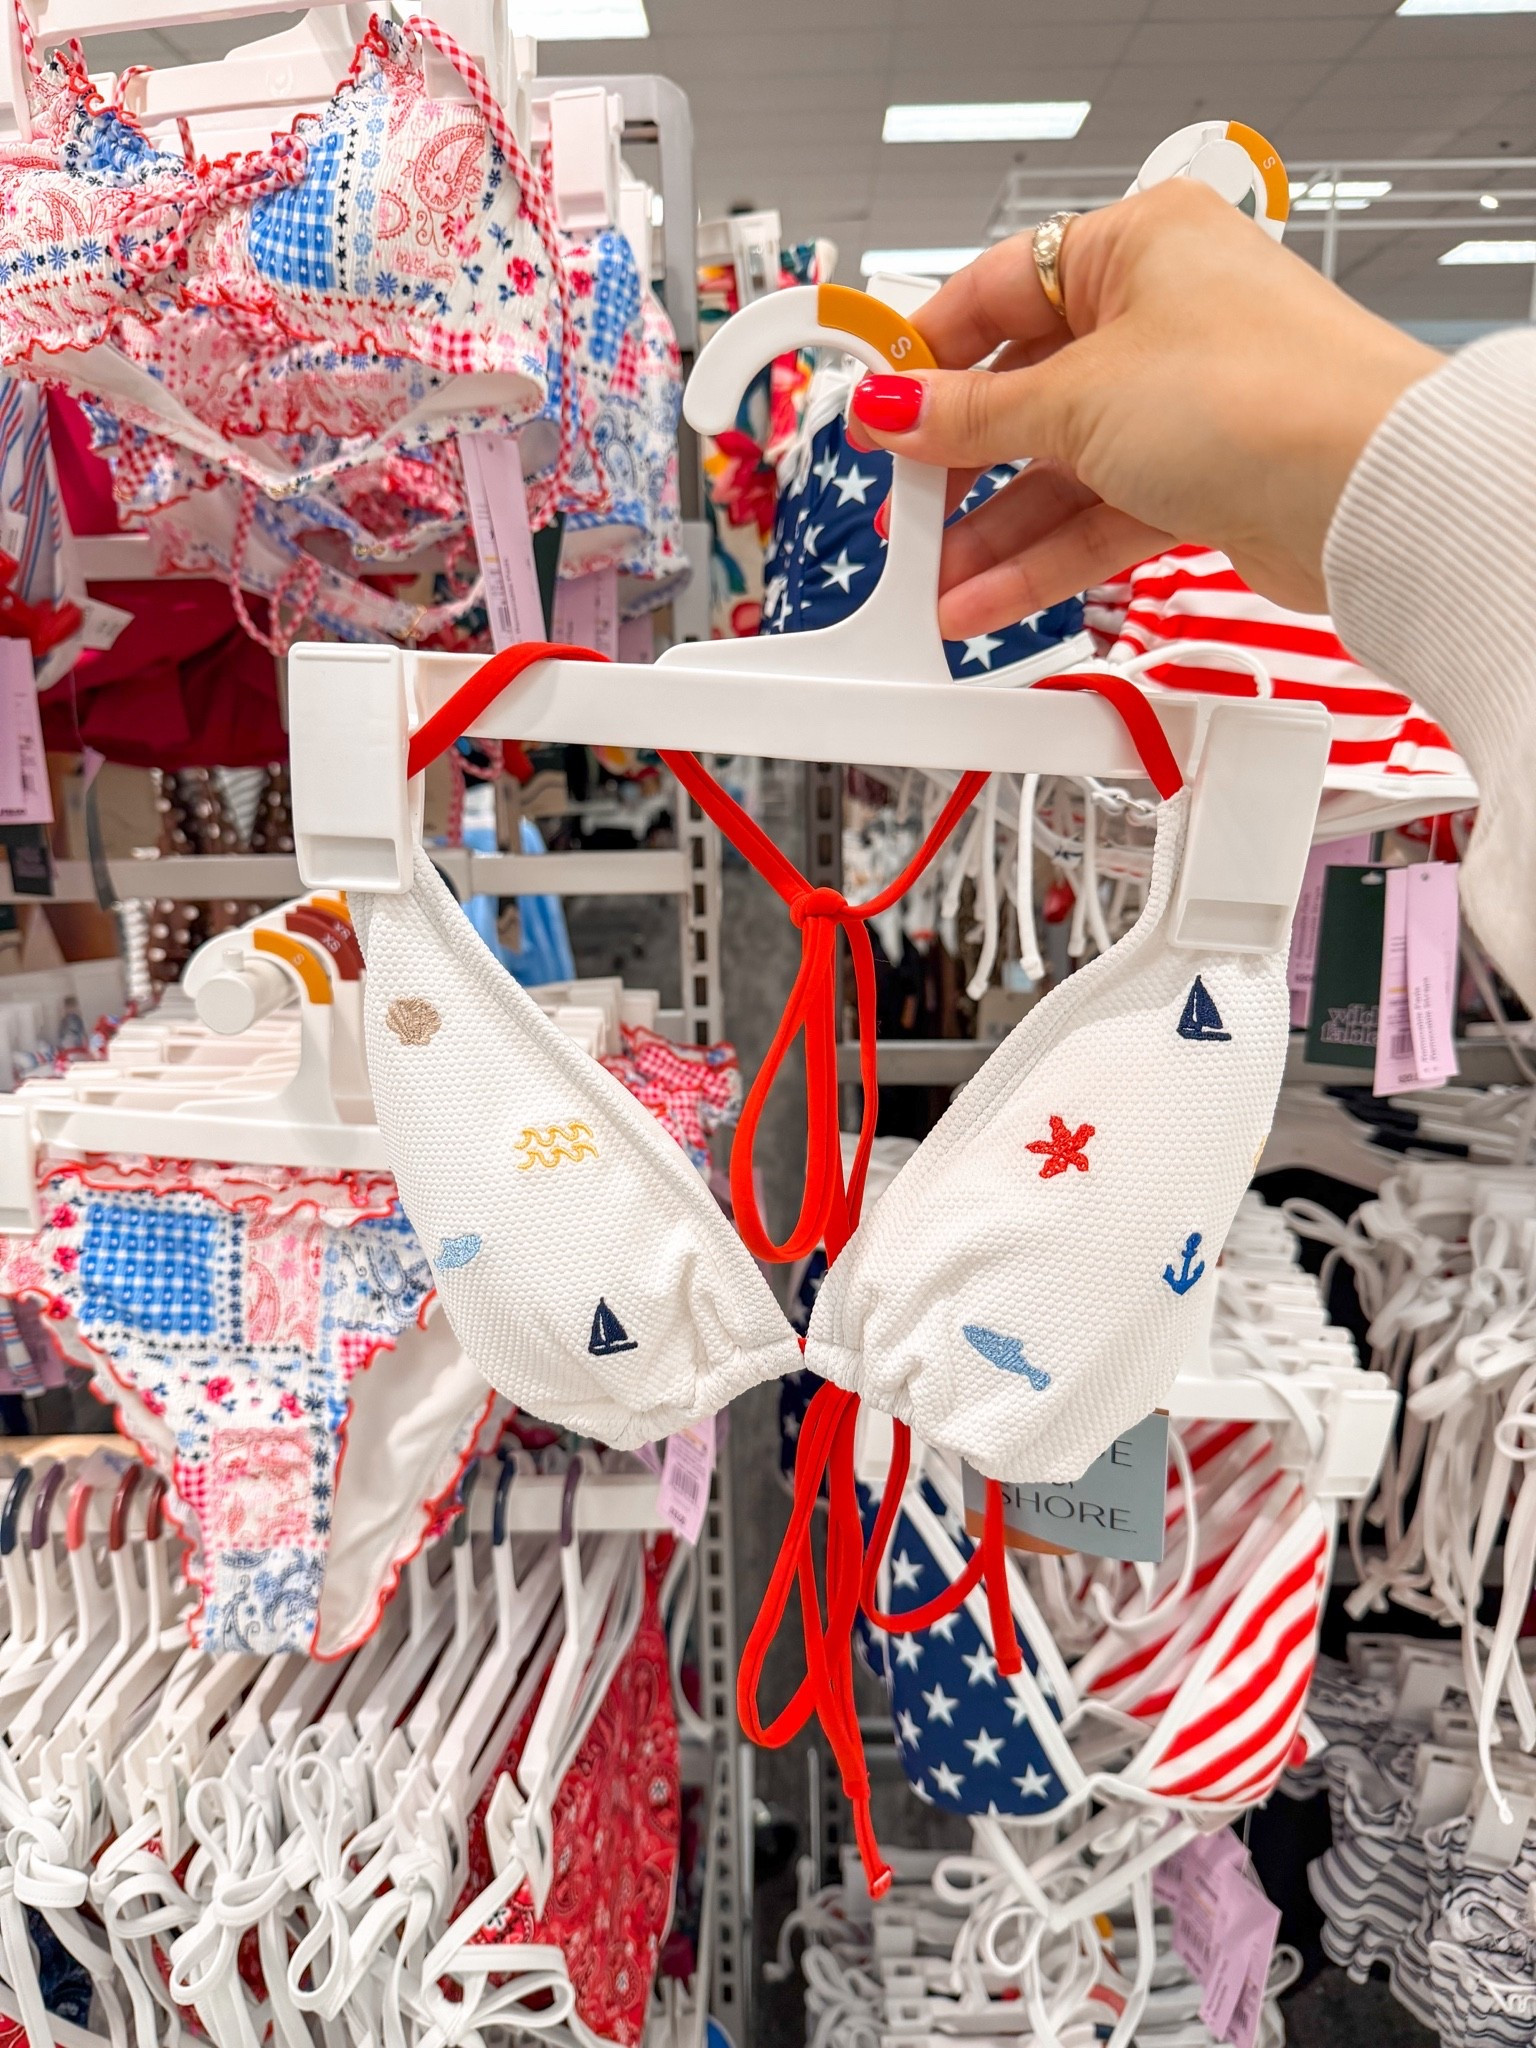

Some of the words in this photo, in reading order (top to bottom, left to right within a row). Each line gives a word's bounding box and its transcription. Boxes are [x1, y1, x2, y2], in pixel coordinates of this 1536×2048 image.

[1263, 156, 1276, 170] S
[890, 336, 912, 359] S
[333, 920, 351, 941] XS
[321, 933, 341, 953] XS
[292, 953, 305, 966] S
